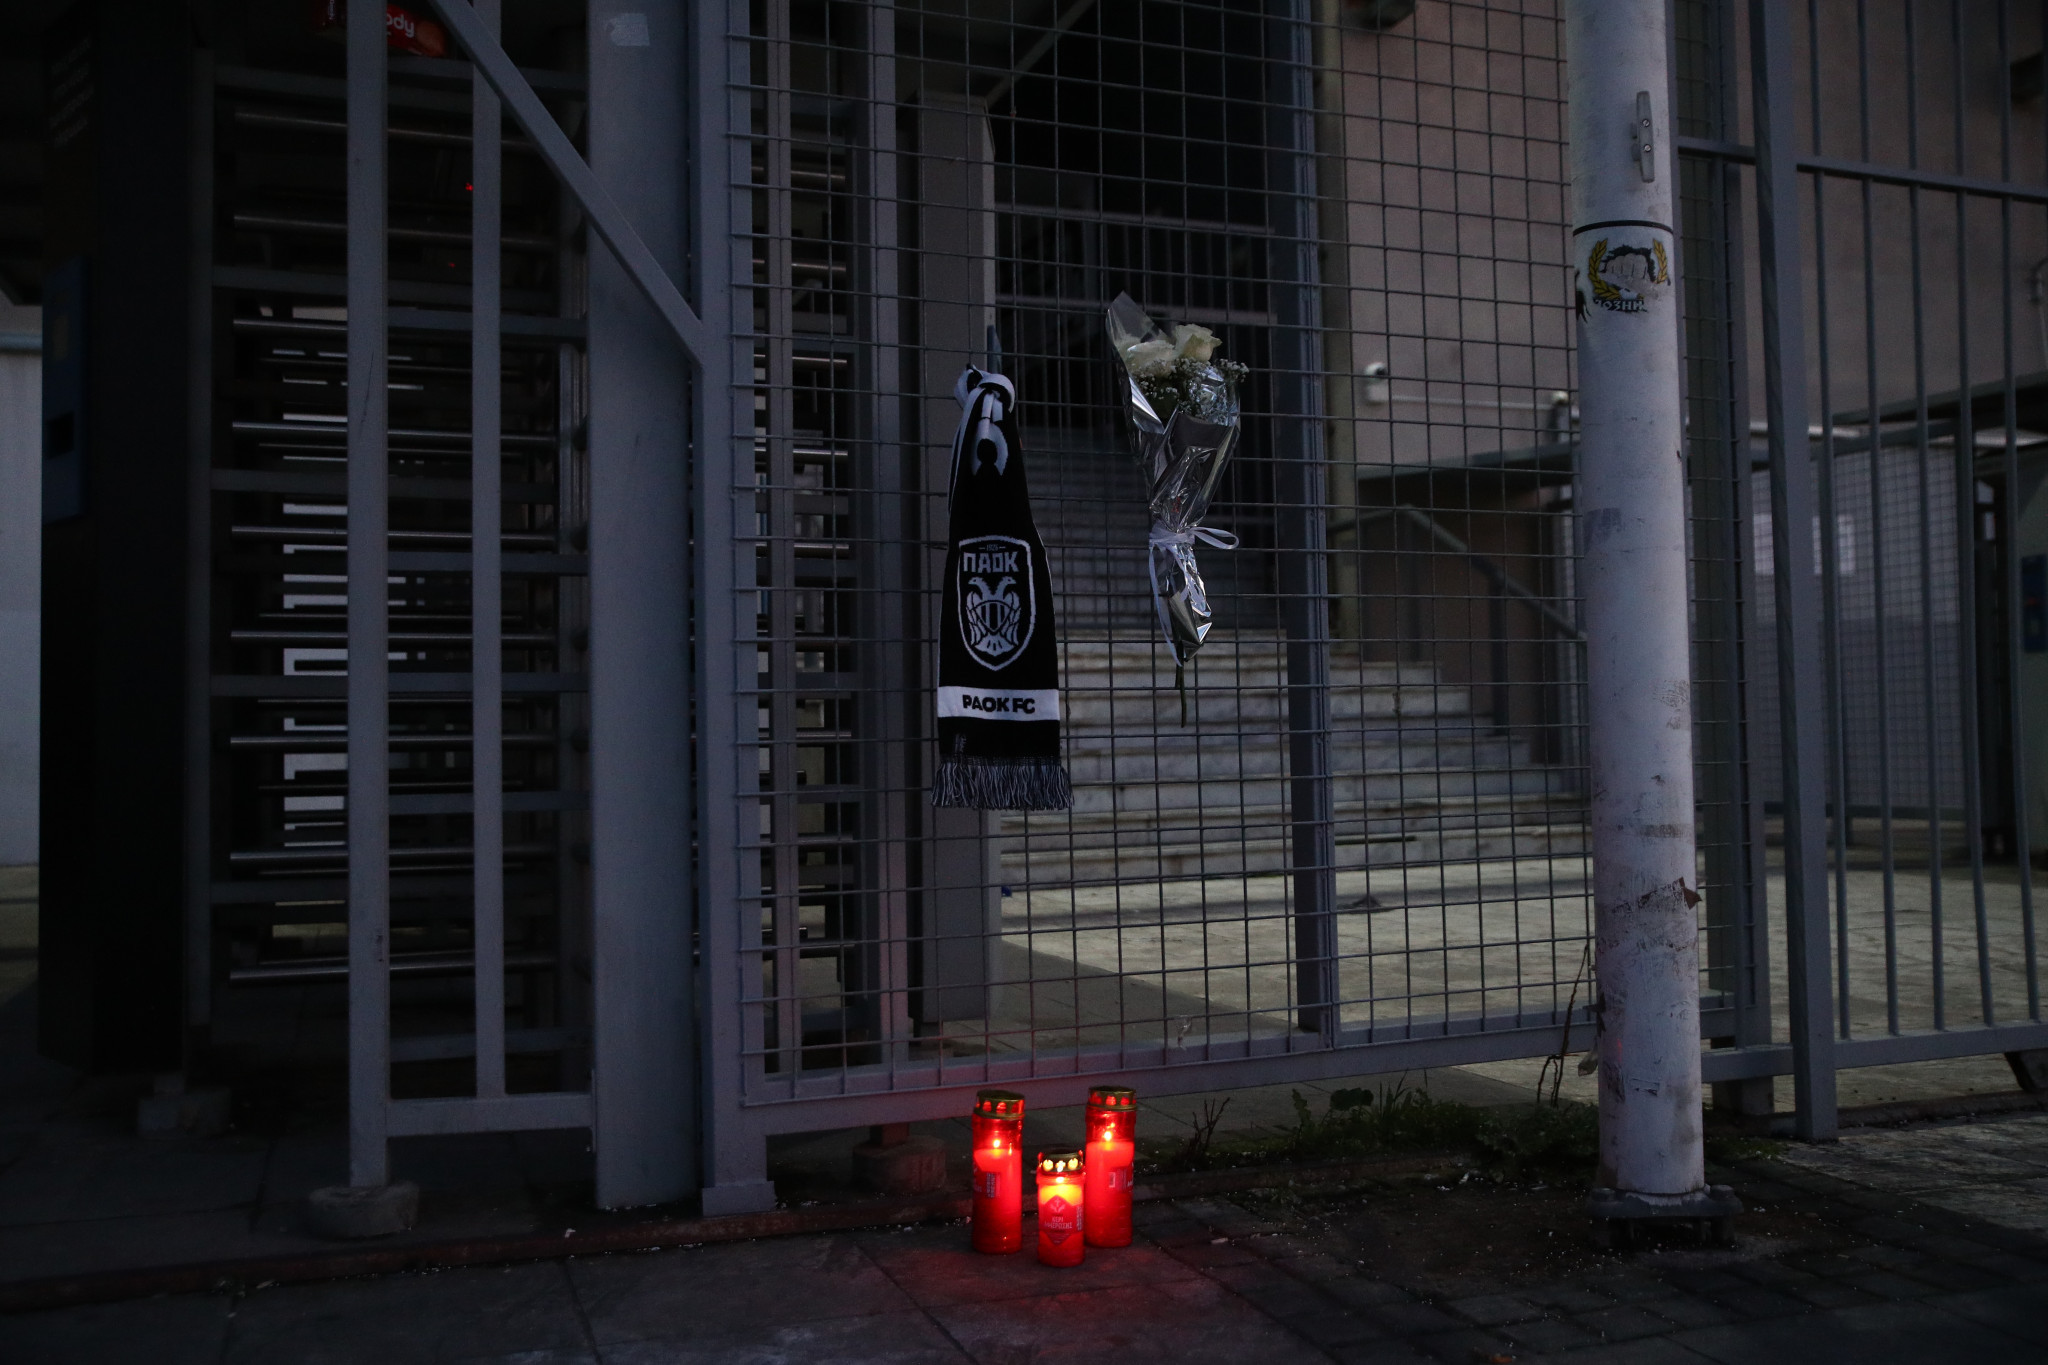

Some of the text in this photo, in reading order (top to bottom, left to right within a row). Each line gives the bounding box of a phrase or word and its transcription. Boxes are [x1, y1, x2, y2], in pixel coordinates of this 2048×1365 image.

[963, 551, 1020, 573] ΠΑΟΚ
[962, 694, 1035, 714] PAOK FC
